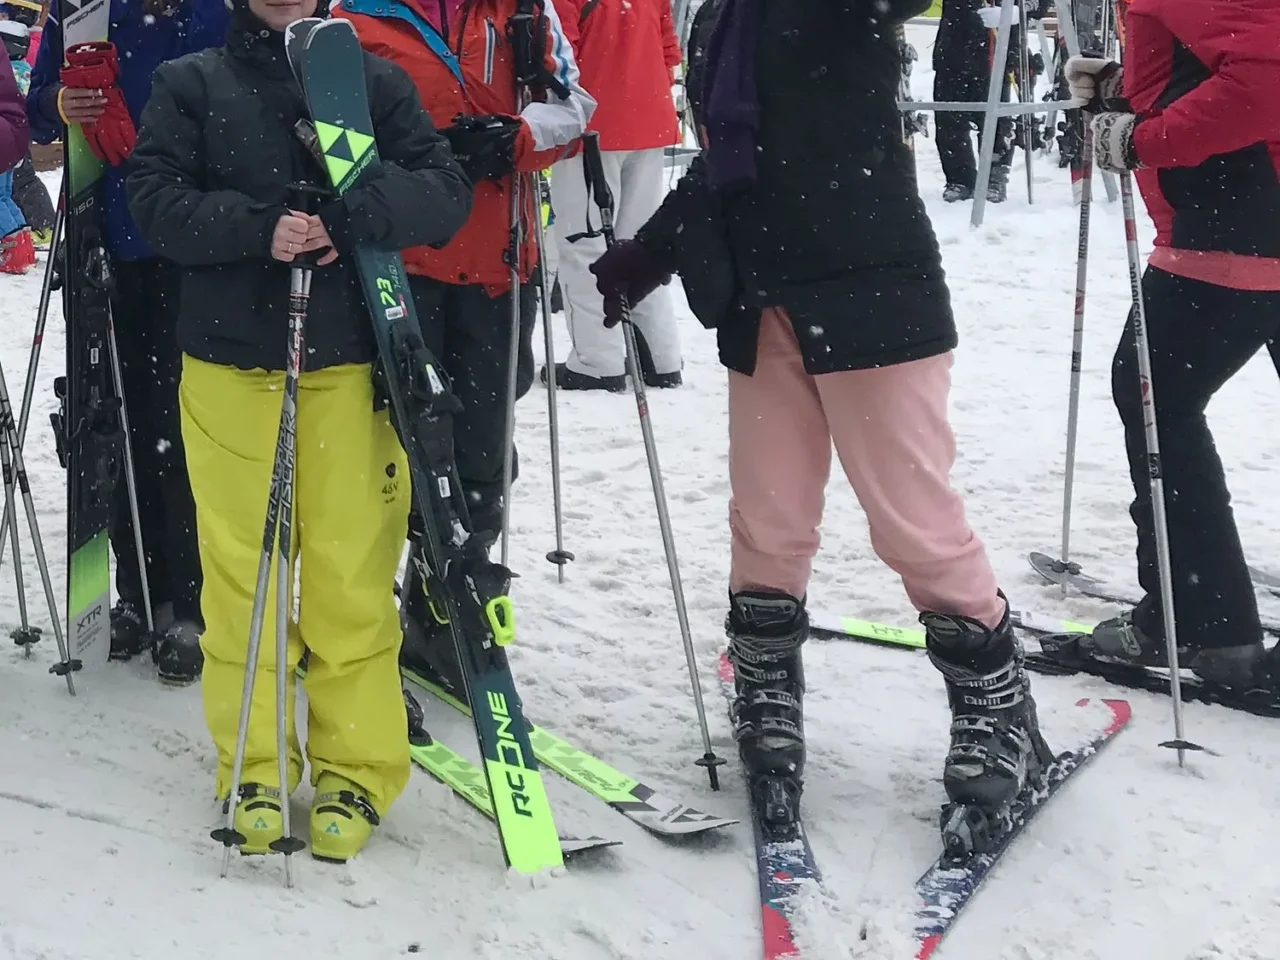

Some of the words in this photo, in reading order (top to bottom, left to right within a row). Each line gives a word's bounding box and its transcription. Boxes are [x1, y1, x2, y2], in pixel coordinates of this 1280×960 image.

[66, 0, 105, 29] FISCHER
[339, 149, 377, 197] FISCHER
[1077, 198, 1091, 260] ROSSIGNOL
[376, 277, 397, 307] 73
[280, 411, 296, 529] FISCHER
[77, 605, 102, 633] XTR
